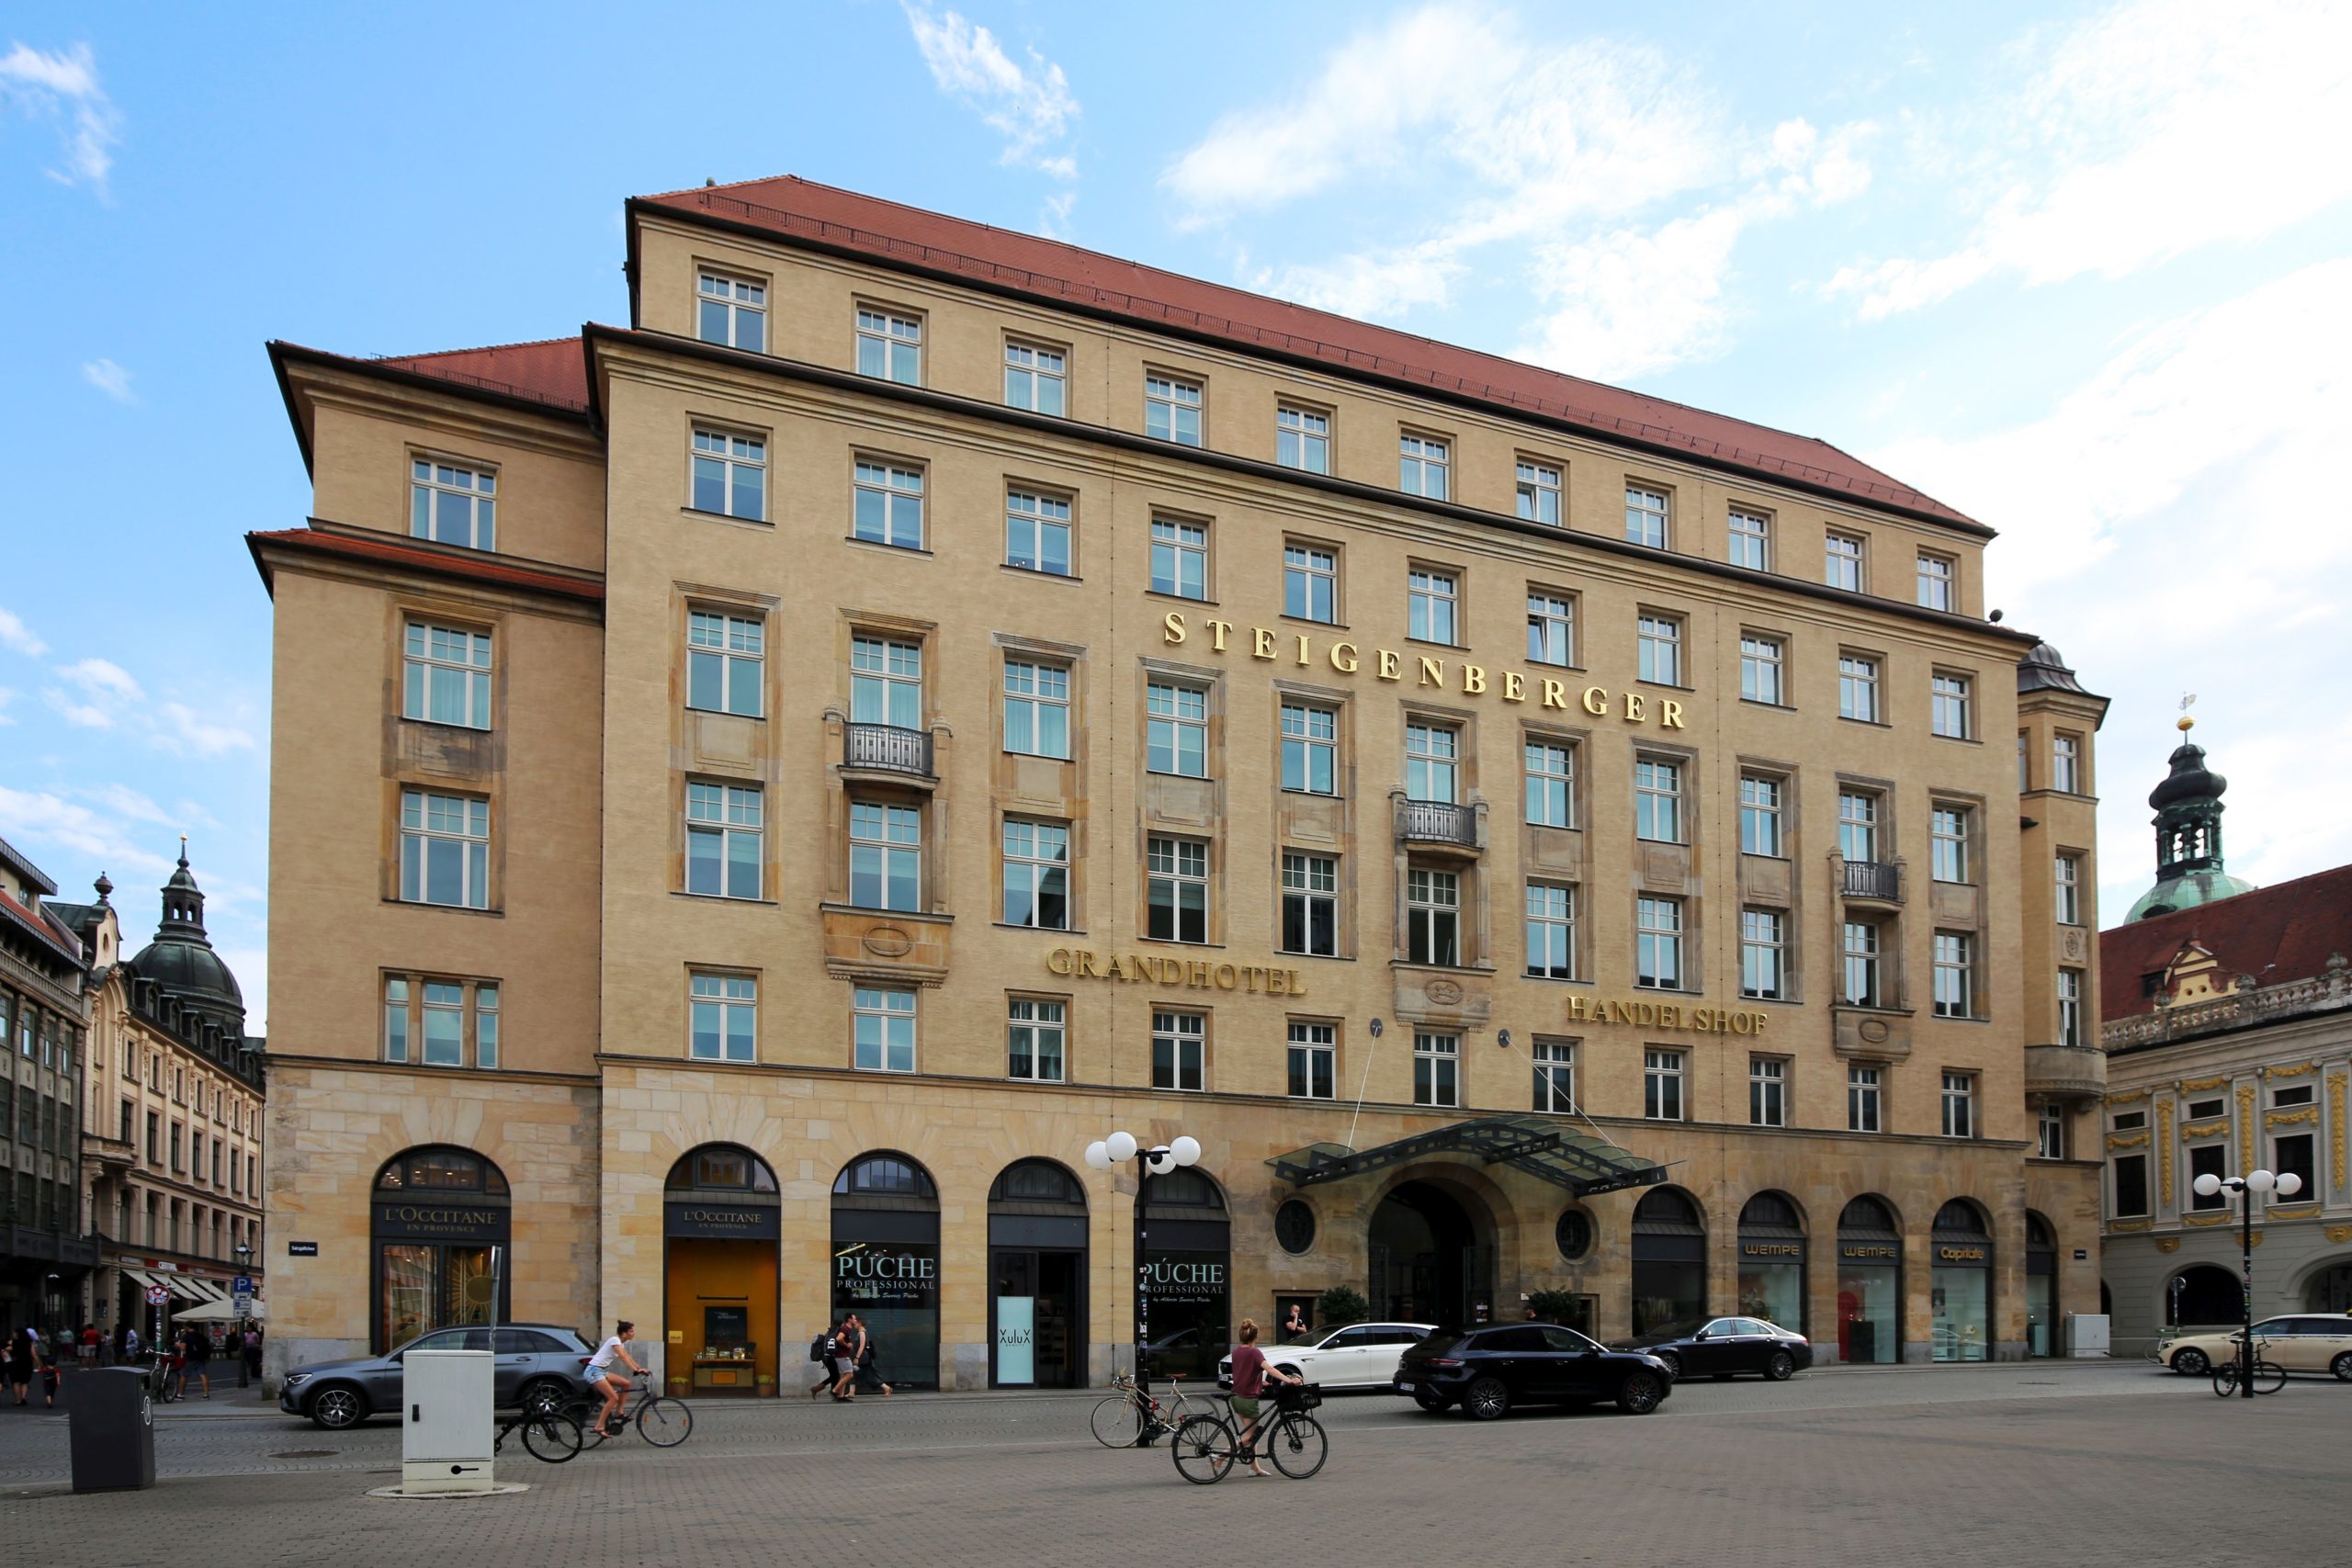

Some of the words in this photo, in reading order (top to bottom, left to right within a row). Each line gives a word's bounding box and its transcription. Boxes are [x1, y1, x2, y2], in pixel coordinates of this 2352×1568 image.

[1163, 611, 1687, 730] STEIGENBERGER
[1046, 946, 1308, 997] GRANDHOTEL
[1567, 995, 1769, 1036] HANDELSHOF
[423, 1224, 476, 1233] PROVENCE
[1745, 1244, 1801, 1256] WEMPE
[1844, 1247, 1896, 1258] WEMPE
[837, 1250, 935, 1279] PÚCHE
[237, 1278, 248, 1291] P
[836, 1280, 934, 1290] PROFESSIONAL
[1146, 1285, 1224, 1294] ROFESSIONAL
